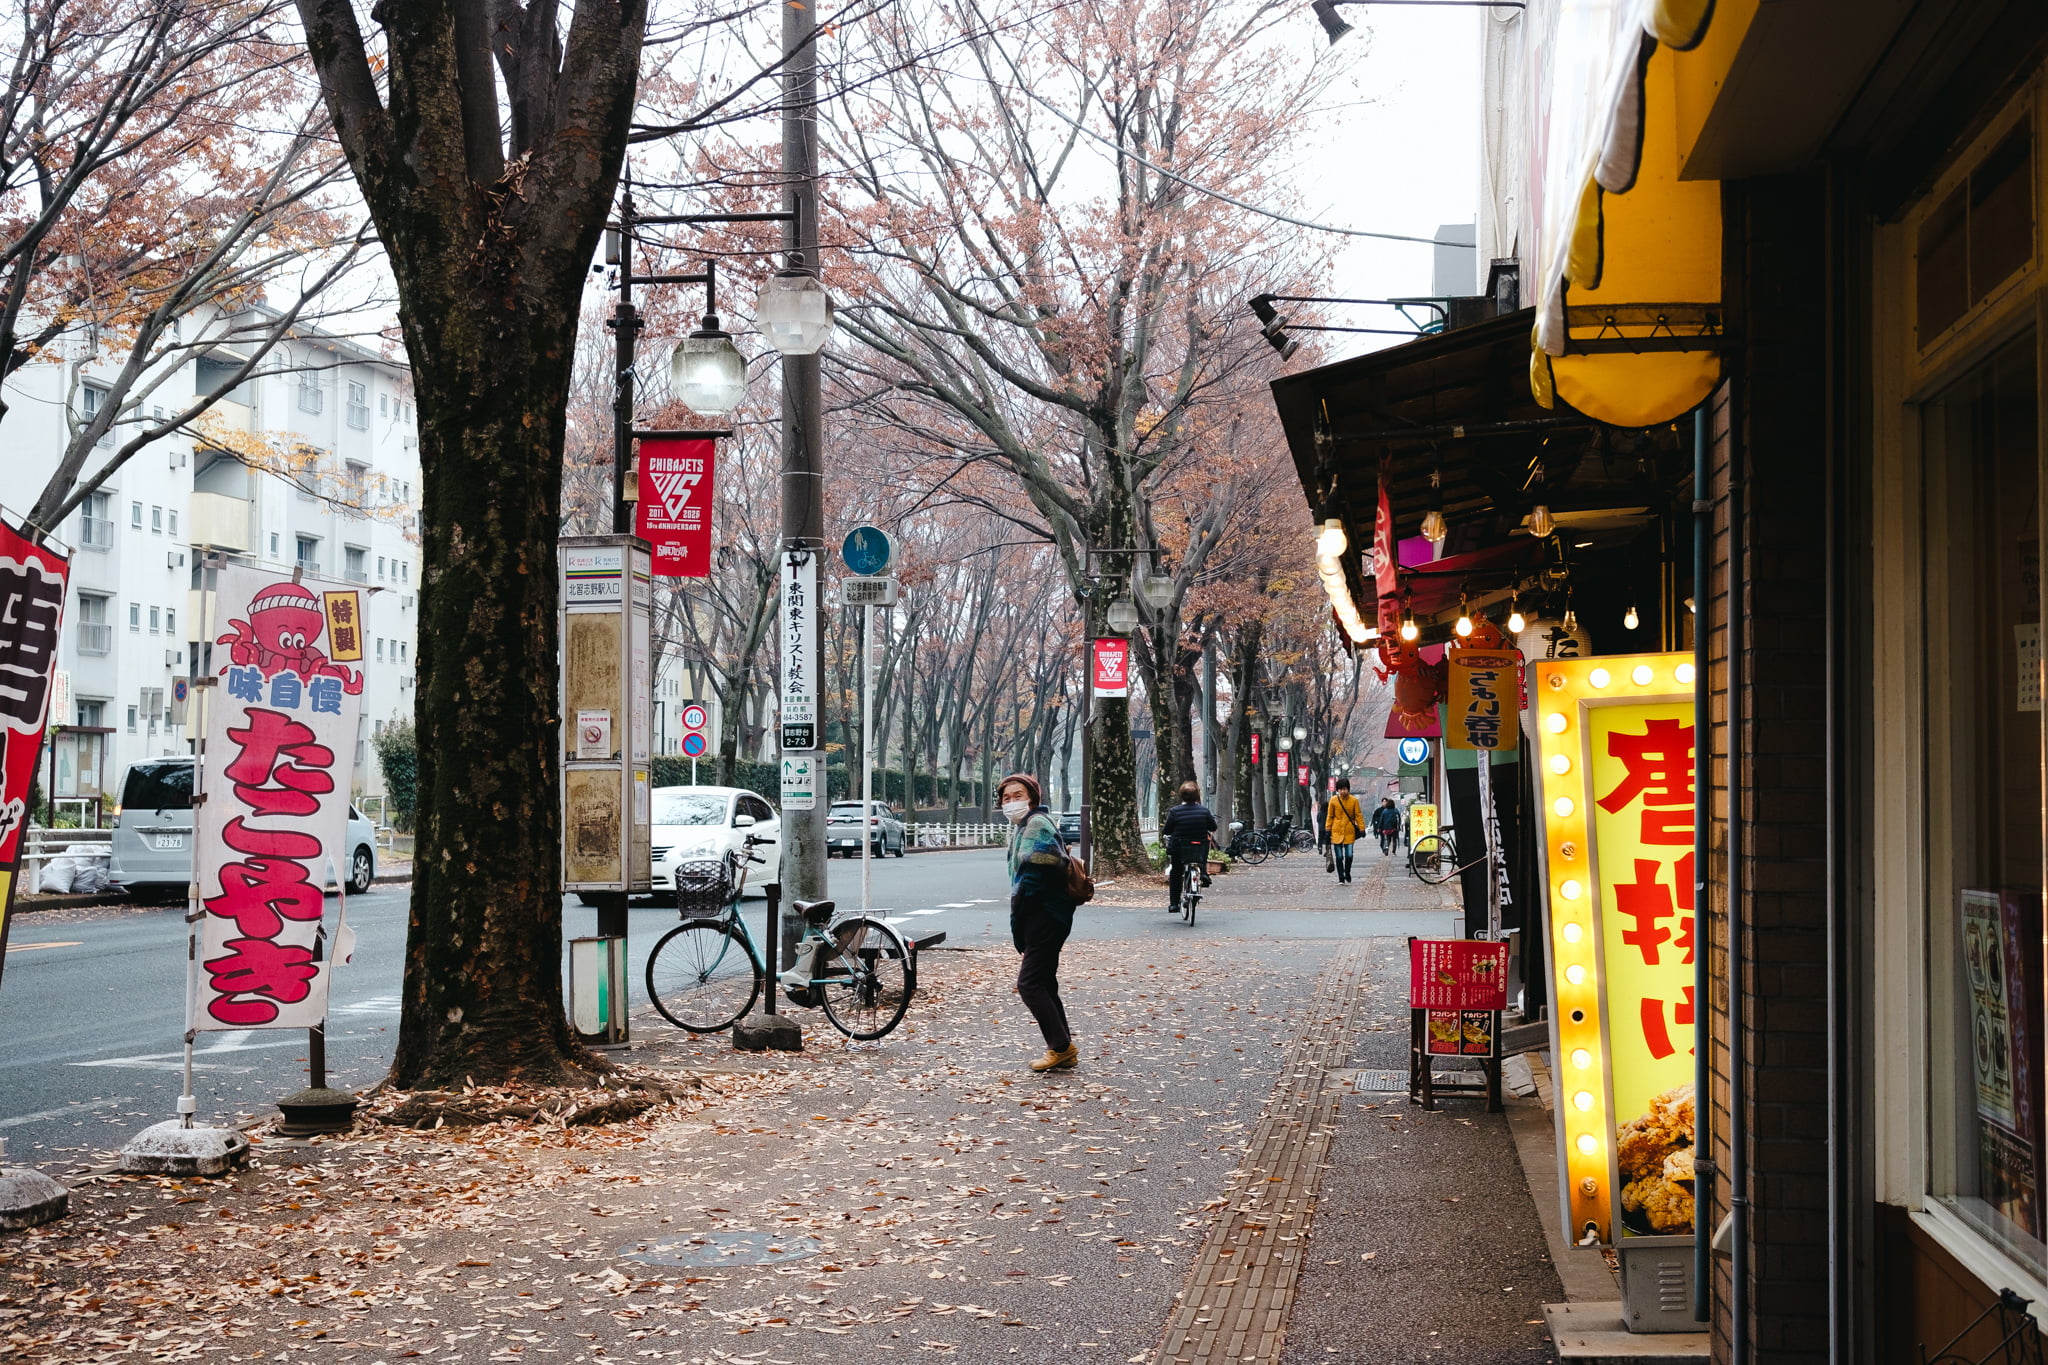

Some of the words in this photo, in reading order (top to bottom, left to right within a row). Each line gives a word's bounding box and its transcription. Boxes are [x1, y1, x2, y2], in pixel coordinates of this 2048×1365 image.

[649, 457, 704, 473] CHIBAJETS
[648, 508, 664, 518] 2011
[658, 522, 702, 531] ANNIVERSARY
[568, 583, 620, 596] 北習志野駅入口
[331, 599, 356, 652] 特製
[787, 581, 806, 693] 東関東キリスト教会
[1541, 626, 1579, 659] た
[227, 667, 343, 715] 味自慢
[687, 713, 701, 724] 40
[786, 738, 806, 746] 2-73
[202, 707, 335, 1025] たこやき
